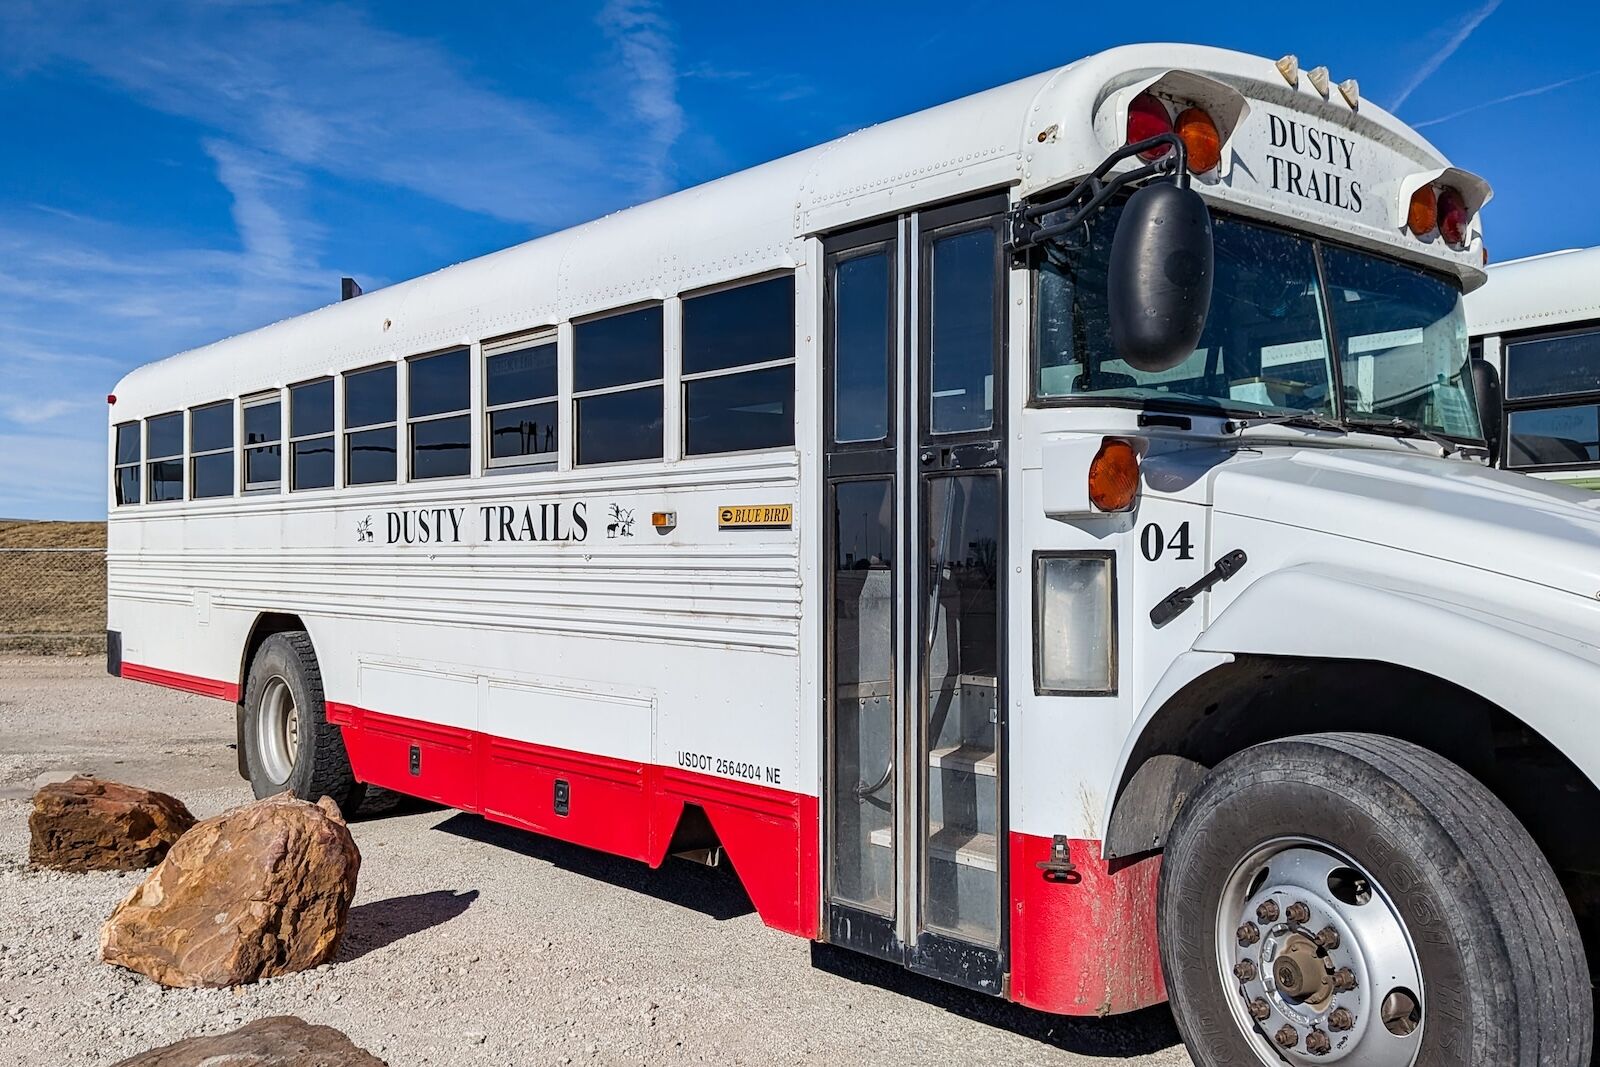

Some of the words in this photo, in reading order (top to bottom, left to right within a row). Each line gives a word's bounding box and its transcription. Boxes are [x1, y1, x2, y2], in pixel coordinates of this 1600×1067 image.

[1267, 113, 1355, 170] DUSTY
[1266, 154, 1362, 213] TRAILS
[387, 508, 465, 544] DUSTY
[479, 501, 588, 542] TRAILS
[734, 508, 761, 523] BLUE
[762, 507, 788, 522] BIRD
[1140, 521, 1194, 562] 04
[678, 751, 712, 771] USDOT
[716, 758, 761, 780] 2564204
[766, 766, 781, 784] NE
